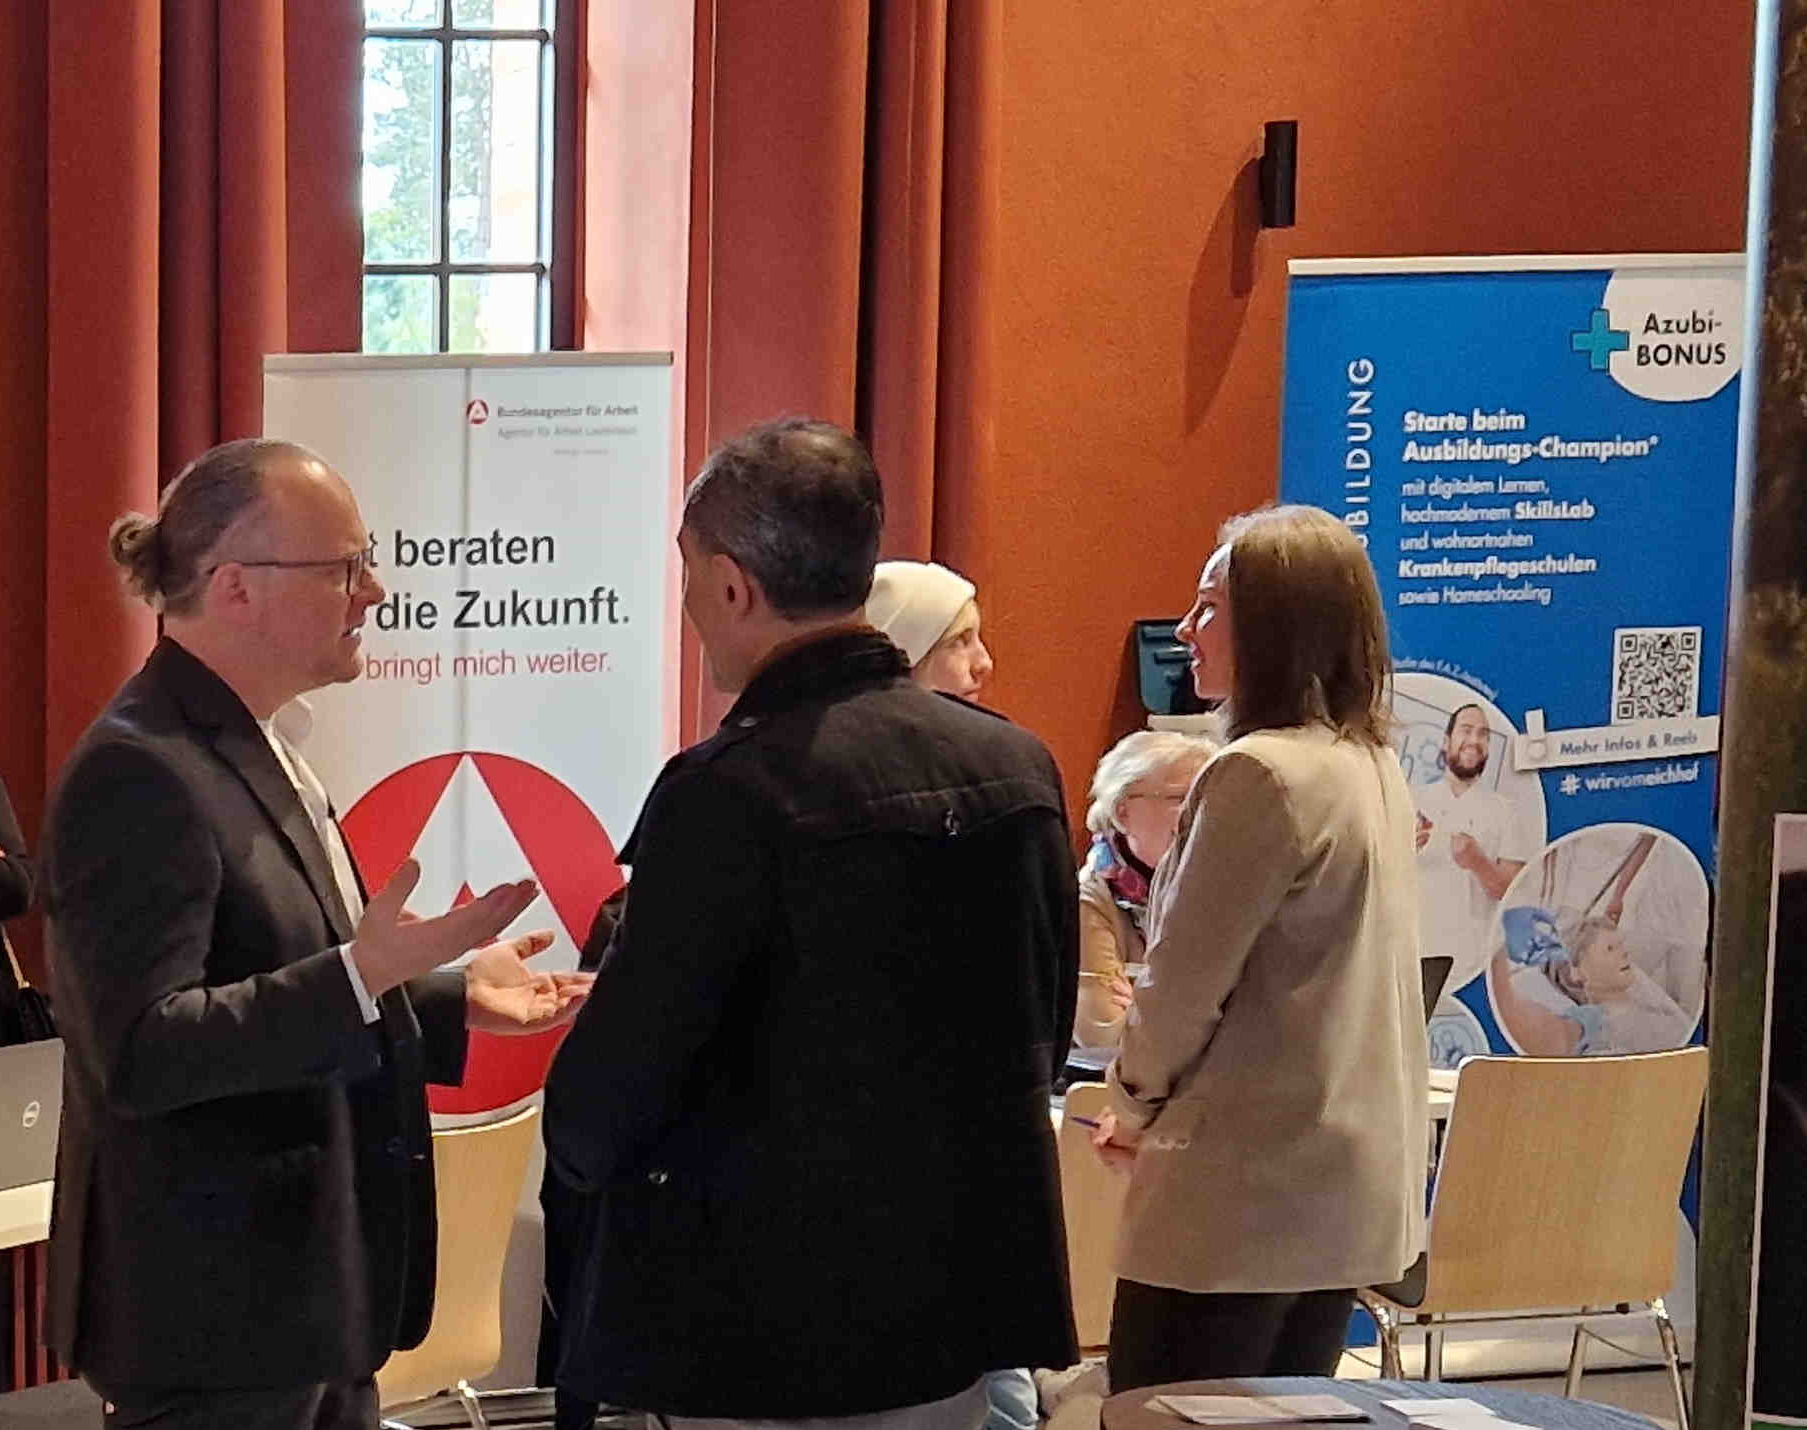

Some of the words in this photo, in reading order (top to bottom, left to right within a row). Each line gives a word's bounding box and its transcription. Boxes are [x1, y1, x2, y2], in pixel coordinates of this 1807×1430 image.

[1643, 309, 1723, 335] Azubi-
[1636, 342, 1727, 366] BONUS
[498, 404, 582, 420] Bundesagentur
[585, 402, 601, 416] für
[603, 402, 638, 416] Arbeit
[1403, 411, 1467, 433] Starte
[1472, 408, 1526, 431] beim
[1401, 478, 1426, 496] mit
[1428, 474, 1495, 499] digitalem
[1401, 502, 1511, 523] hochmodernem
[1514, 498, 1595, 519] SkillsLab
[394, 529, 555, 567] beraten
[1400, 530, 1429, 550] und
[1432, 528, 1534, 549] wohnortnahen
[1399, 553, 1597, 580] Krankenpflegeschulen
[376, 592, 438, 631] die
[453, 586, 630, 629] Zukunft.
[365, 651, 442, 686] bringt
[453, 648, 516, 677] mich
[527, 645, 612, 675] weiter.
[1560, 739, 1598, 755] Mehr
[1605, 736, 1641, 751] Infos
[1648, 733, 1658, 748] &
